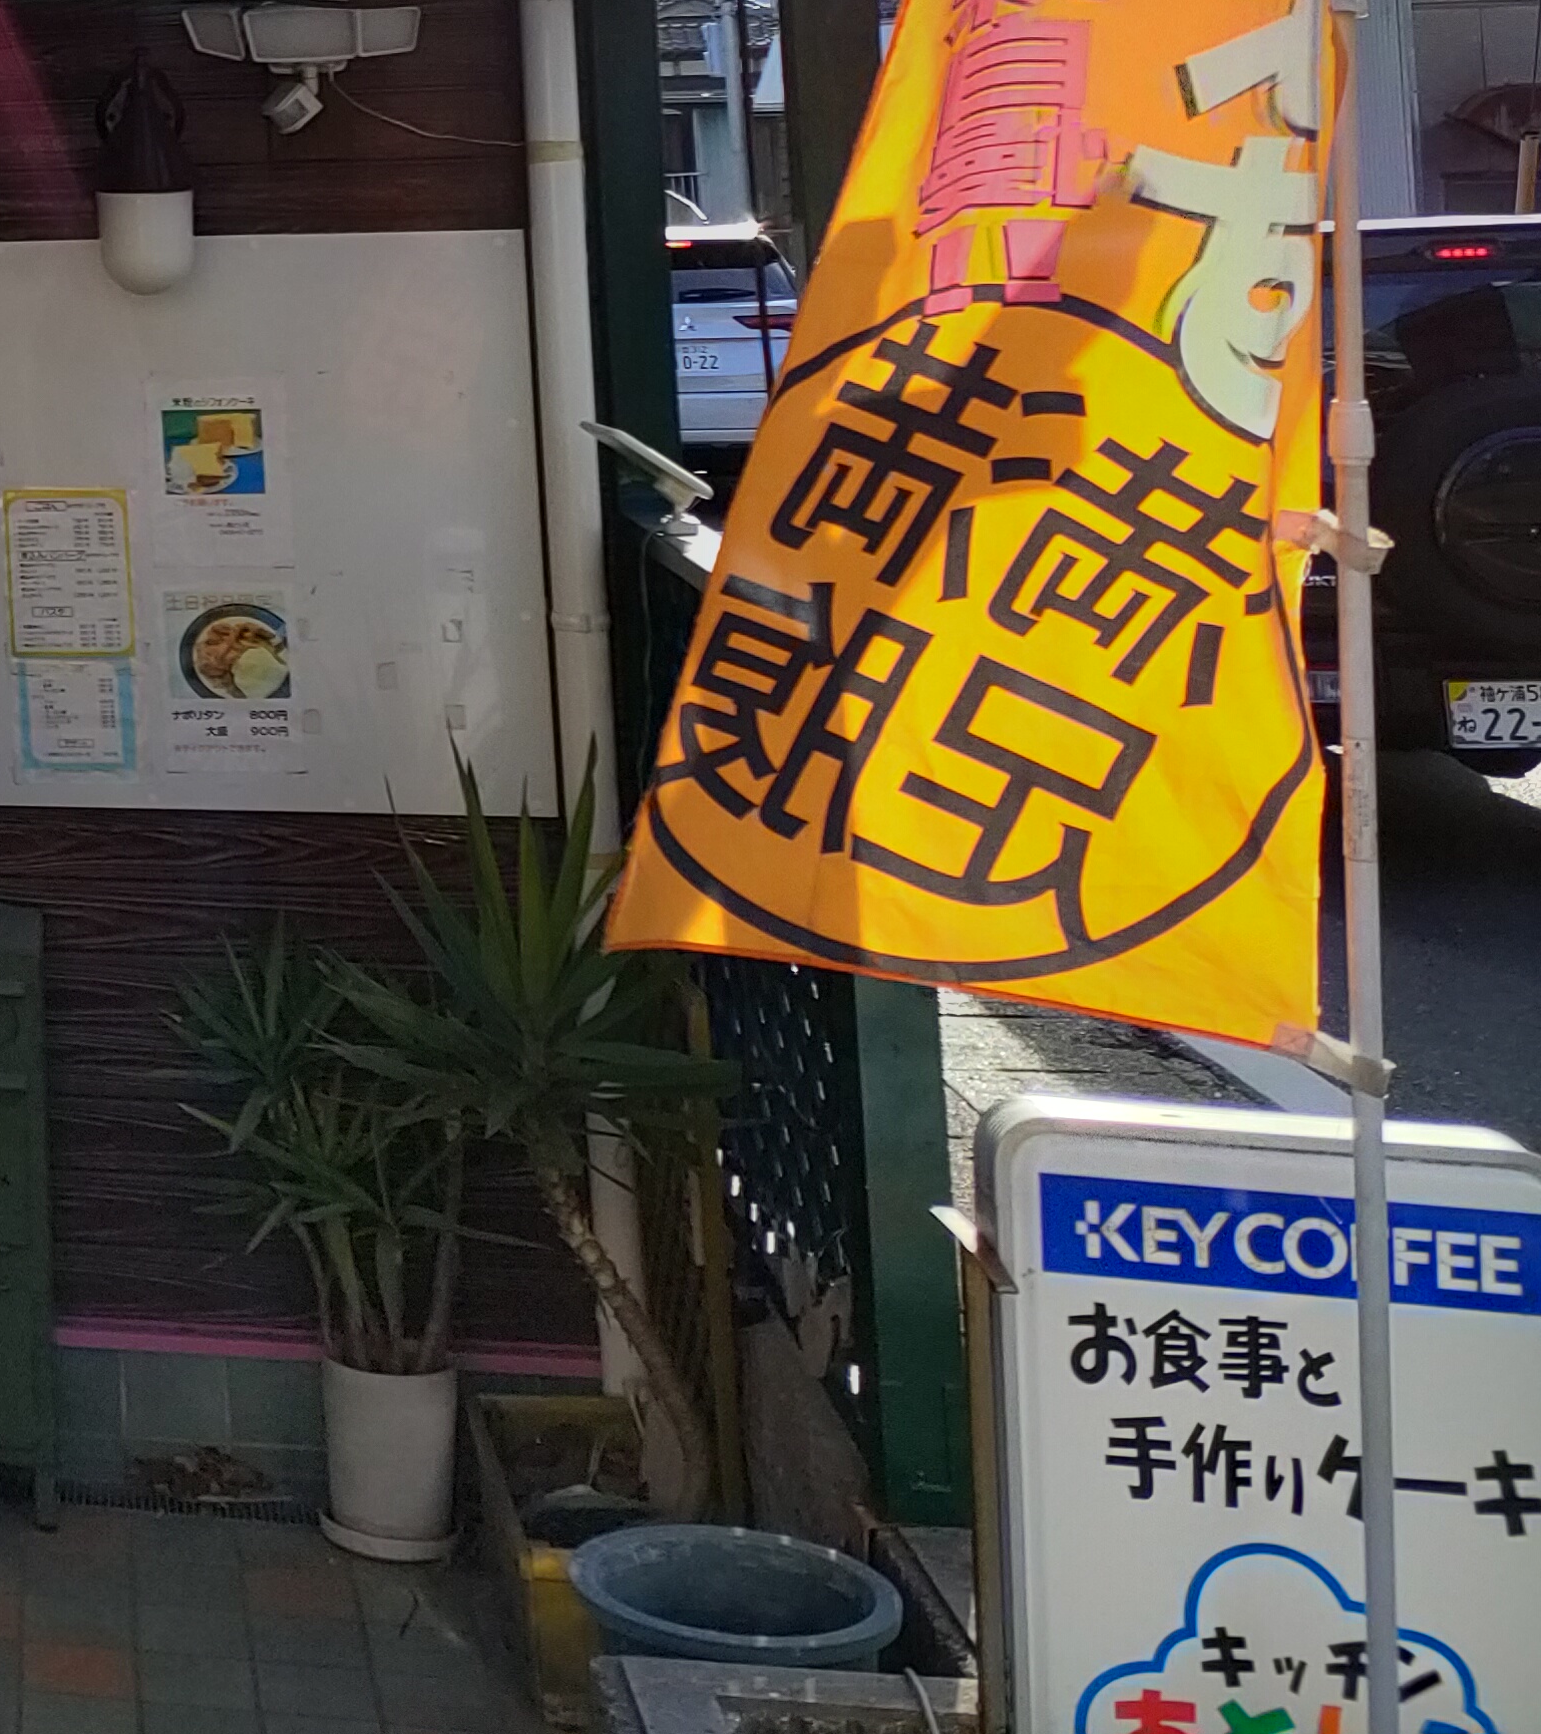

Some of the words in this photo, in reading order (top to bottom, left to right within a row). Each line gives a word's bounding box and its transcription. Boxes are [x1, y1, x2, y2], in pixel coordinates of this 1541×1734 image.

[683, 355, 719, 370] 0-22
[171, 709, 225, 721] ナポリタン
[249, 709, 288, 721] 800円
[1480, 685, 1541, 702] 袖ケ浦5
[250, 726, 289, 737] 900円
[1075, 1200, 1230, 1268] KEY
[1234, 1212, 1523, 1296] COFEE
[1068, 1302, 1342, 1407] お食事と
[1105, 1416, 1541, 1537] 手作りケーキ
[1201, 1626, 1442, 1702] キッチン
